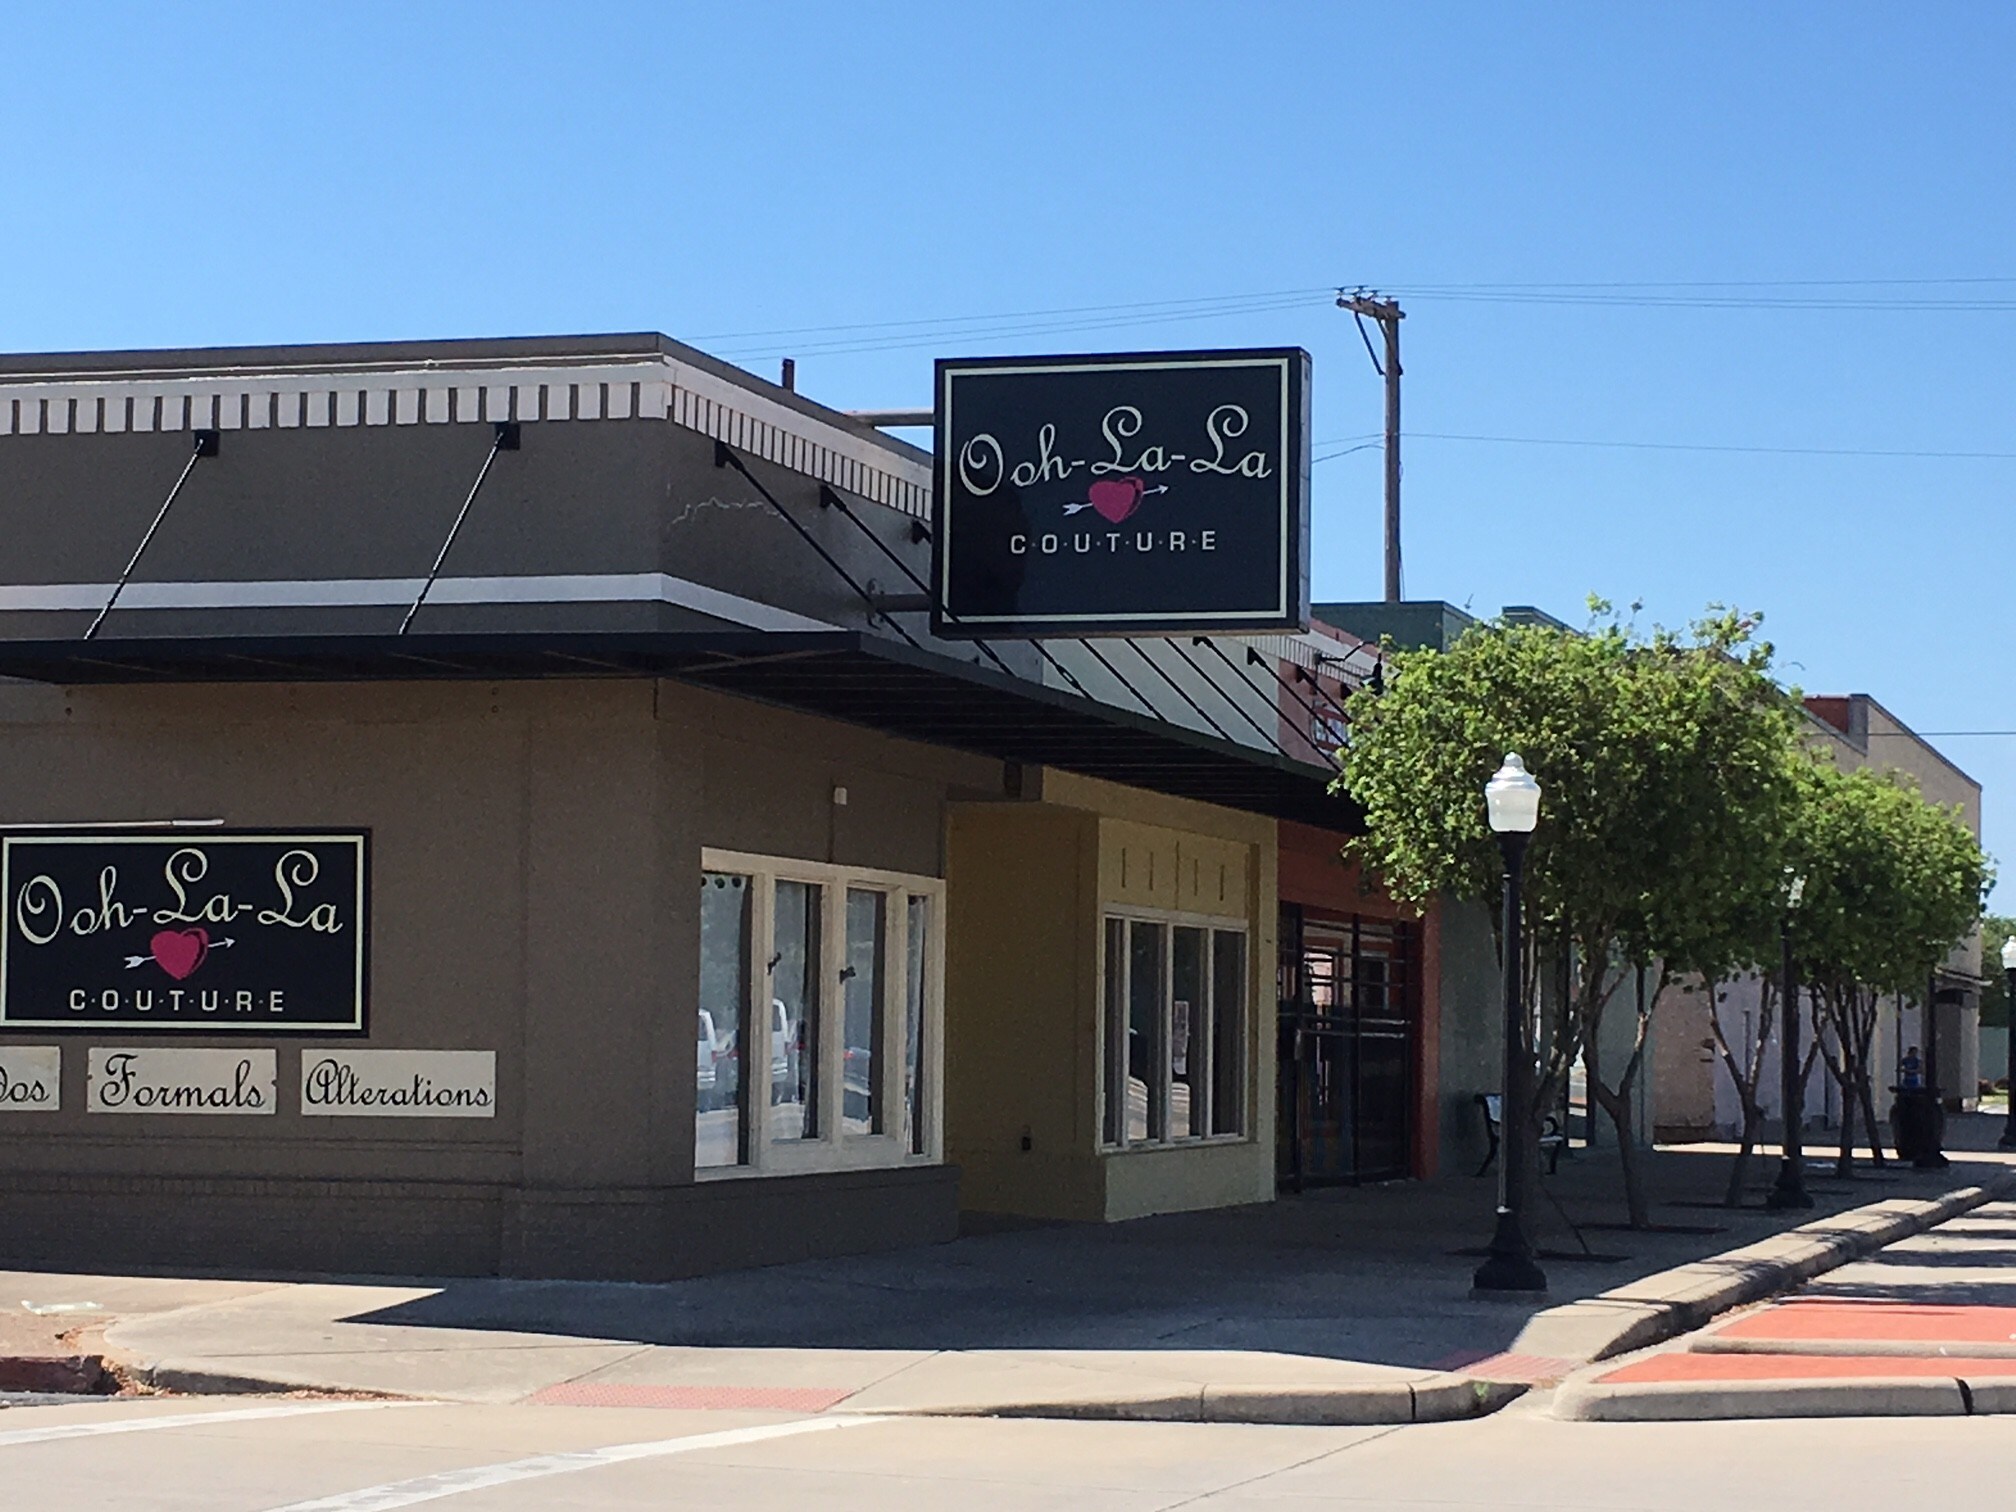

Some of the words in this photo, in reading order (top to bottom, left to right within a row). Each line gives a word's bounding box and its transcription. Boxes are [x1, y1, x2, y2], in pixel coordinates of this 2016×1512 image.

[959, 404, 1272, 496] Ooh-La-La
[16, 847, 343, 945] Ooh-La-La
[100, 1053, 267, 1107] Formals
[305, 1058, 493, 1108] Alterations
